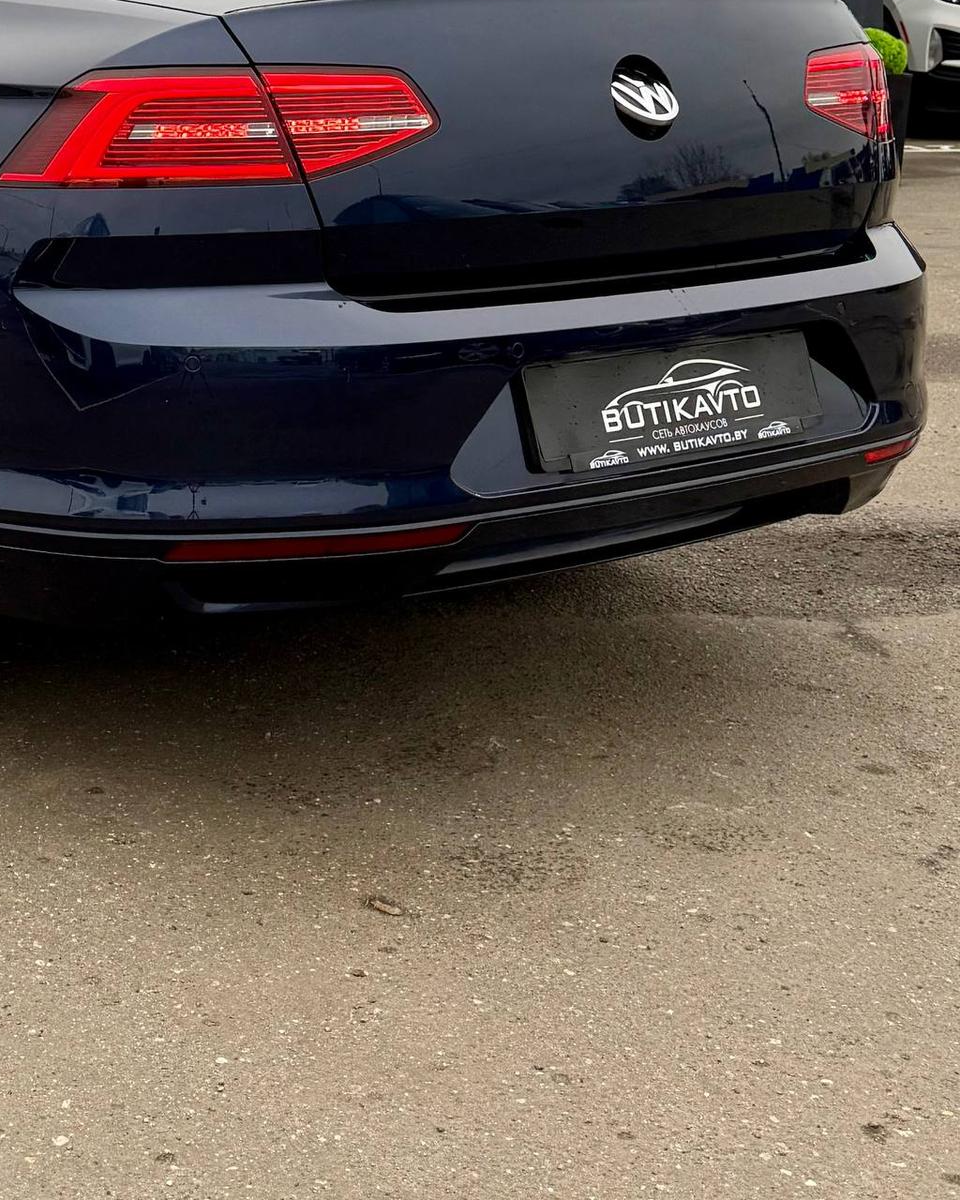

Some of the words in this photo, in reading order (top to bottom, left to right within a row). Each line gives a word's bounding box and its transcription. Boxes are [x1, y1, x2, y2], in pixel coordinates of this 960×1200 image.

[602, 385, 761, 433] BUTIKAVTO
[637, 443, 670, 458] WWW.
[673, 429, 748, 452] BUTIKAVTO.BY
[652, 428, 673, 440] СЕТЬ
[674, 418, 728, 437] АВТОХАУСОВ
